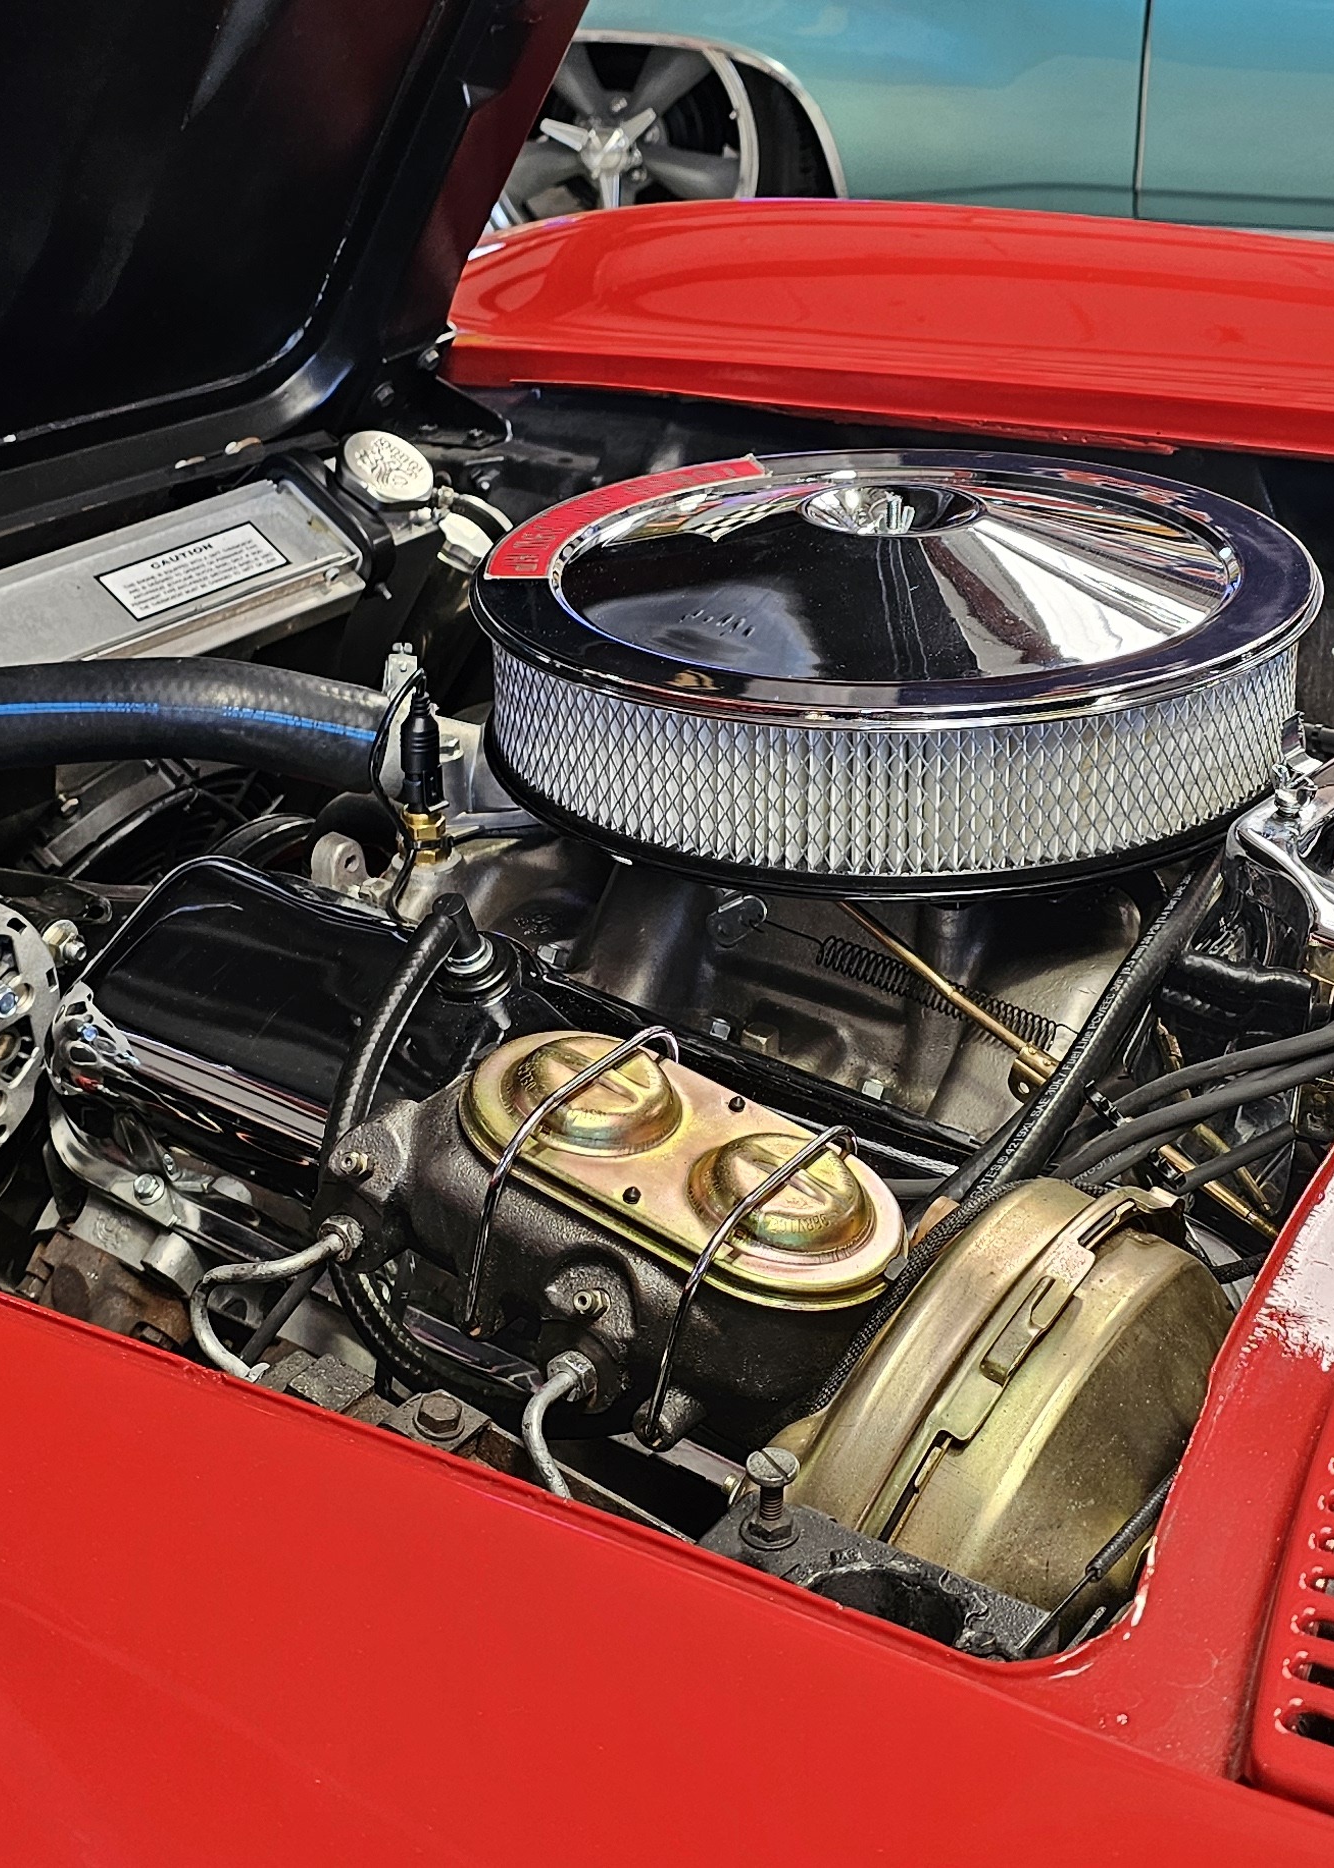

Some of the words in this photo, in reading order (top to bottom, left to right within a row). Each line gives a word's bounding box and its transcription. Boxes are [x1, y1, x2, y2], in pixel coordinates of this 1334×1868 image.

[150, 542, 214, 570] CAUTION
[1030, 1097, 1050, 1118] SAE
[1061, 1050, 1082, 1071] Fuel
[1075, 1030, 1094, 1049] Line
